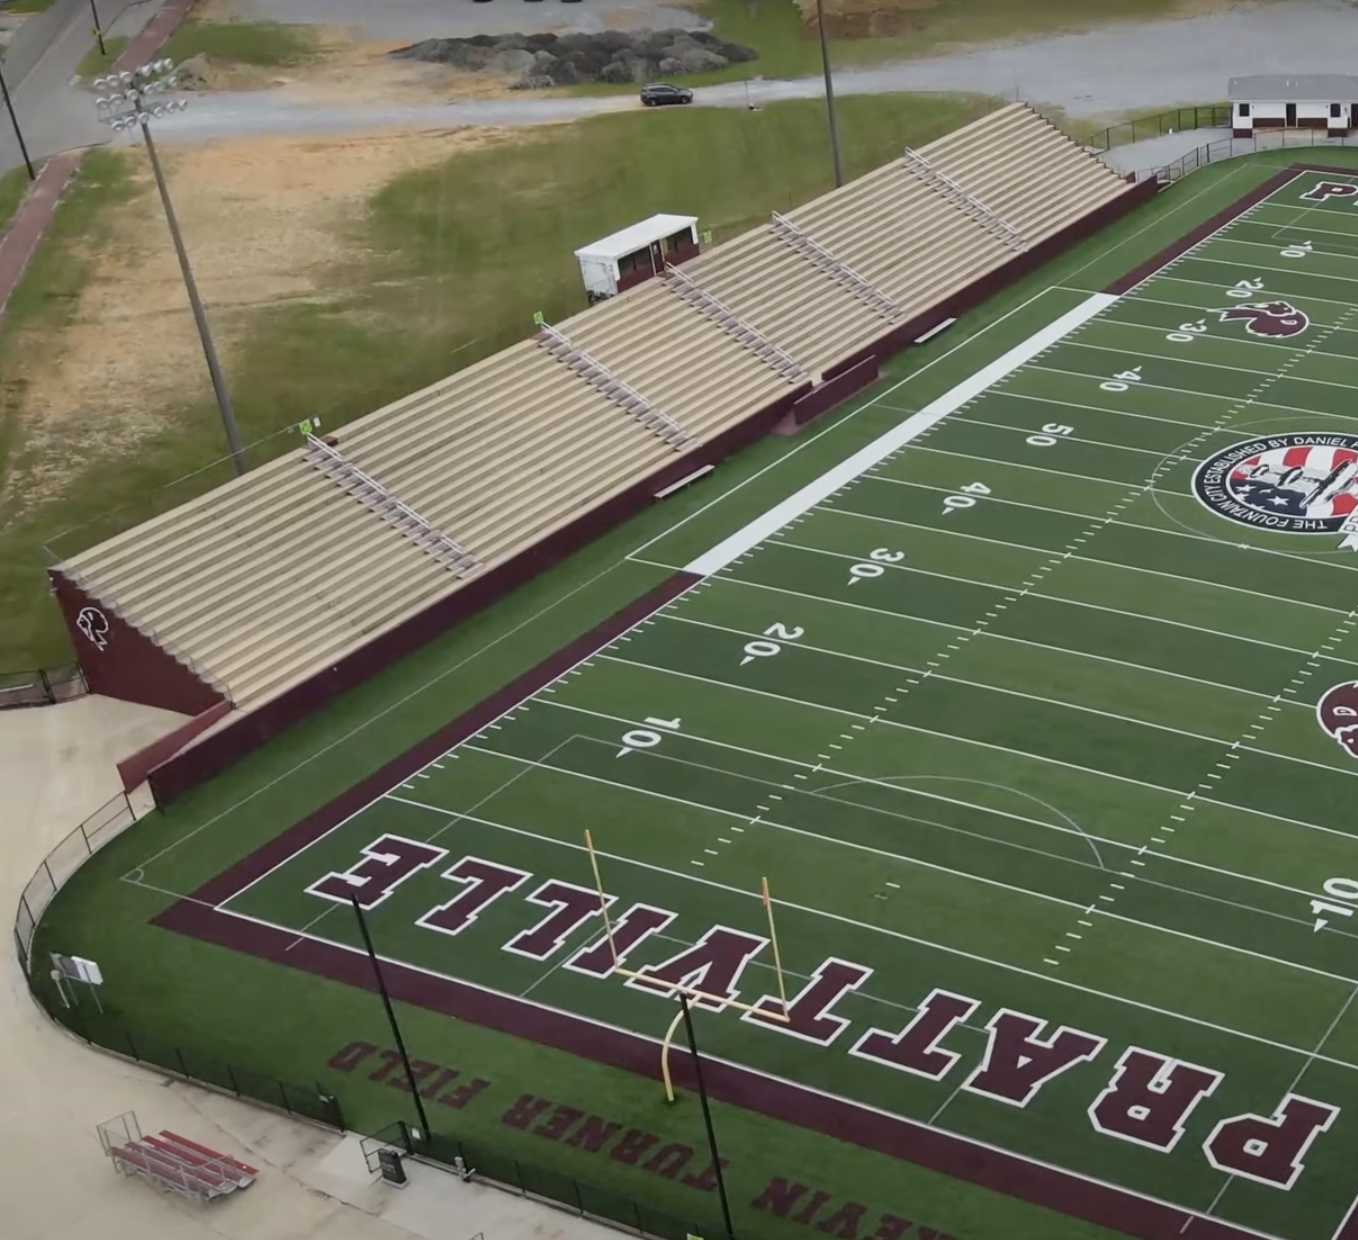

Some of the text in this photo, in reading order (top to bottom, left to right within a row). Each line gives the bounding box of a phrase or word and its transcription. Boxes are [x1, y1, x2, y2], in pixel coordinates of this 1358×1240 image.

[1280, 244, 1313, 258] 10
[1226, 279, 1264, 298] 20
[1166, 322, 1207, 342] 30
[1099, 370, 1142, 392] 40
[1026, 423, 1075, 447] 50
[1203, 442, 1267, 484] ESTABLISHED
[1268, 437, 1288, 448] BY
[1293, 436, 1348, 447] DANIEL
[943, 481, 991, 508] 40
[1203, 485, 1329, 530] THE FOUNTAIN CITY
[849, 547, 905, 578] 30
[743, 622, 805, 657] 20
[622, 717, 682, 748] 10
[303, 833, 1341, 1191] PRATTVILLE
[327, 1040, 492, 1110] FIELD
[501, 1093, 730, 1192] TURNER
